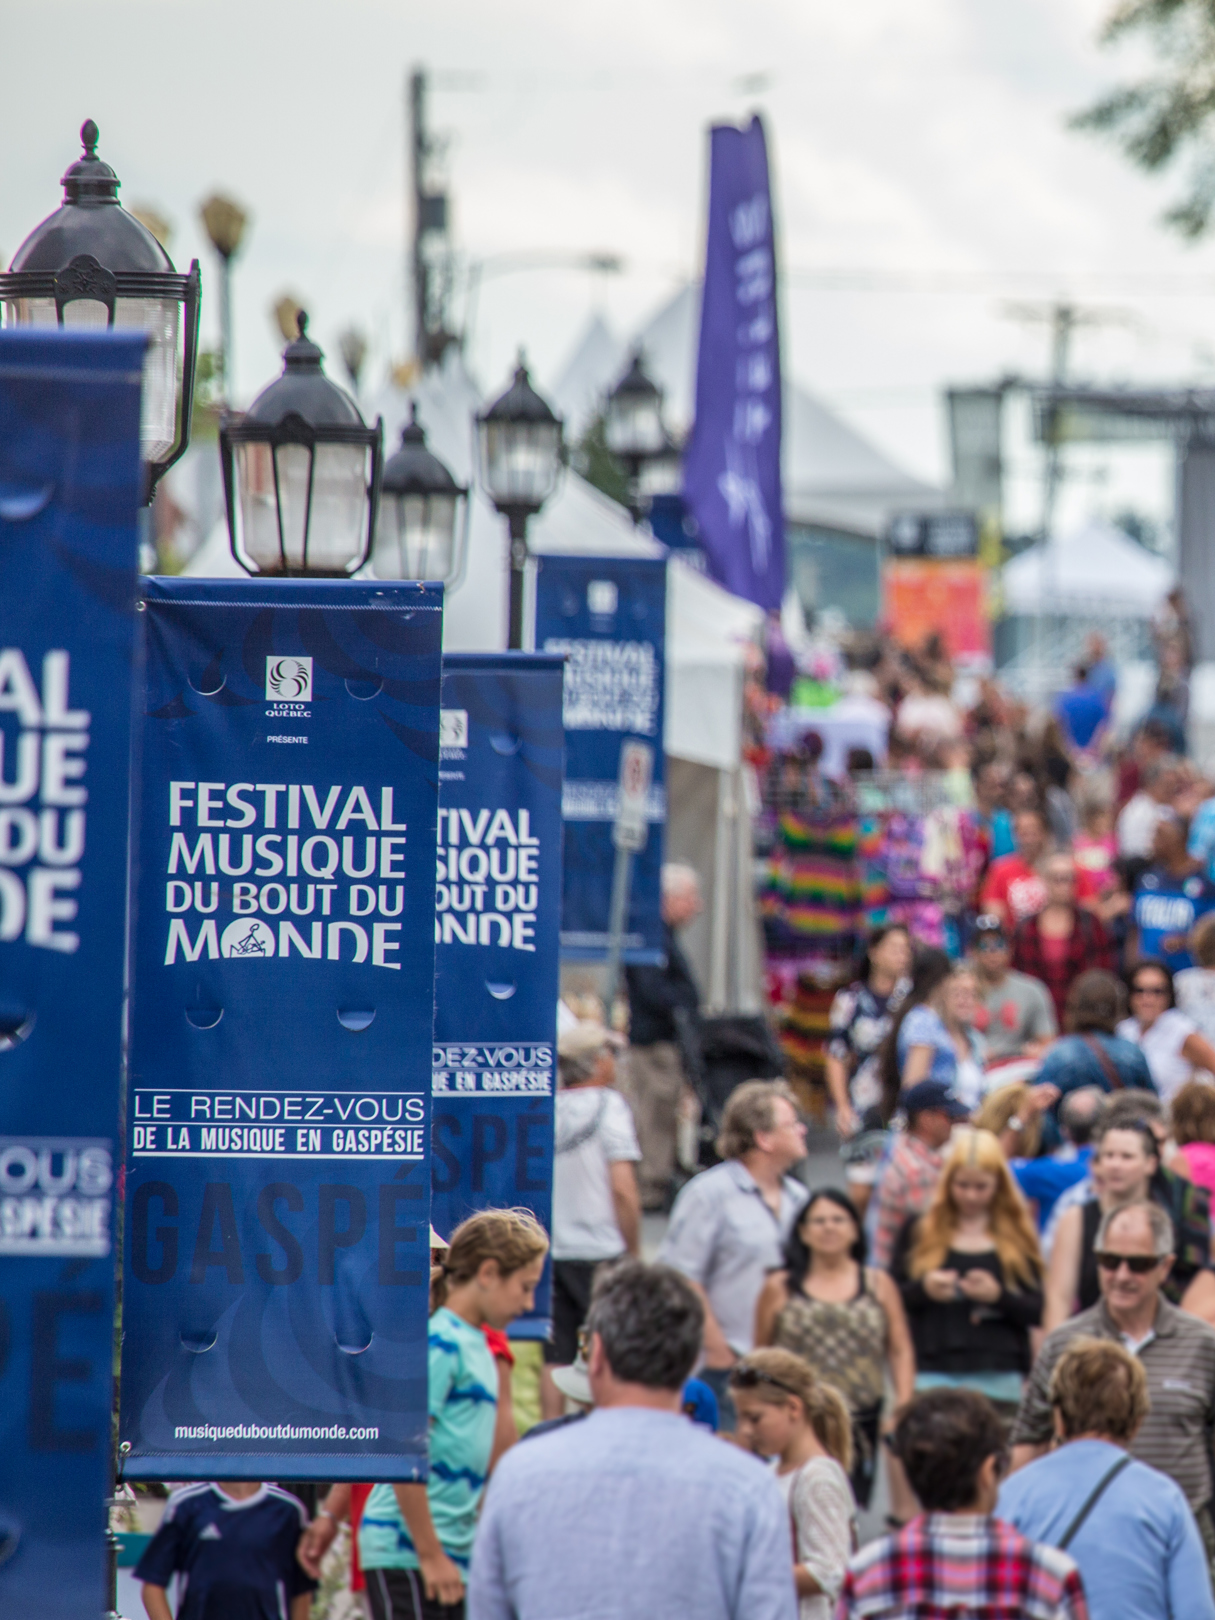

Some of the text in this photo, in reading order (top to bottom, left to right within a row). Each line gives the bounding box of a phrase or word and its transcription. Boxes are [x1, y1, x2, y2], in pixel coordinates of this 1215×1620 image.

[265, 709, 312, 718] QUÉBEC
[266, 734, 309, 744] PRÉSENTE
[169, 781, 407, 831] FESTIVAL
[167, 832, 406, 879] MUSIQUE
[166, 880, 404, 916] DU BOUT DU
[495, 884, 538, 911] DU
[164, 917, 402, 970] MONDE
[455, 1071, 477, 1091] EN
[481, 1068, 552, 1091] GASPÉSIE
[134, 1095, 425, 1121] LE RENDEZ-VOUS
[133, 1126, 425, 1152] DE LA MUSIQUE EN GASPÉSIE
[131, 1163, 424, 1286] GASPÉ
[174, 1423, 379, 1441] musiqueduboutdumonde.com
